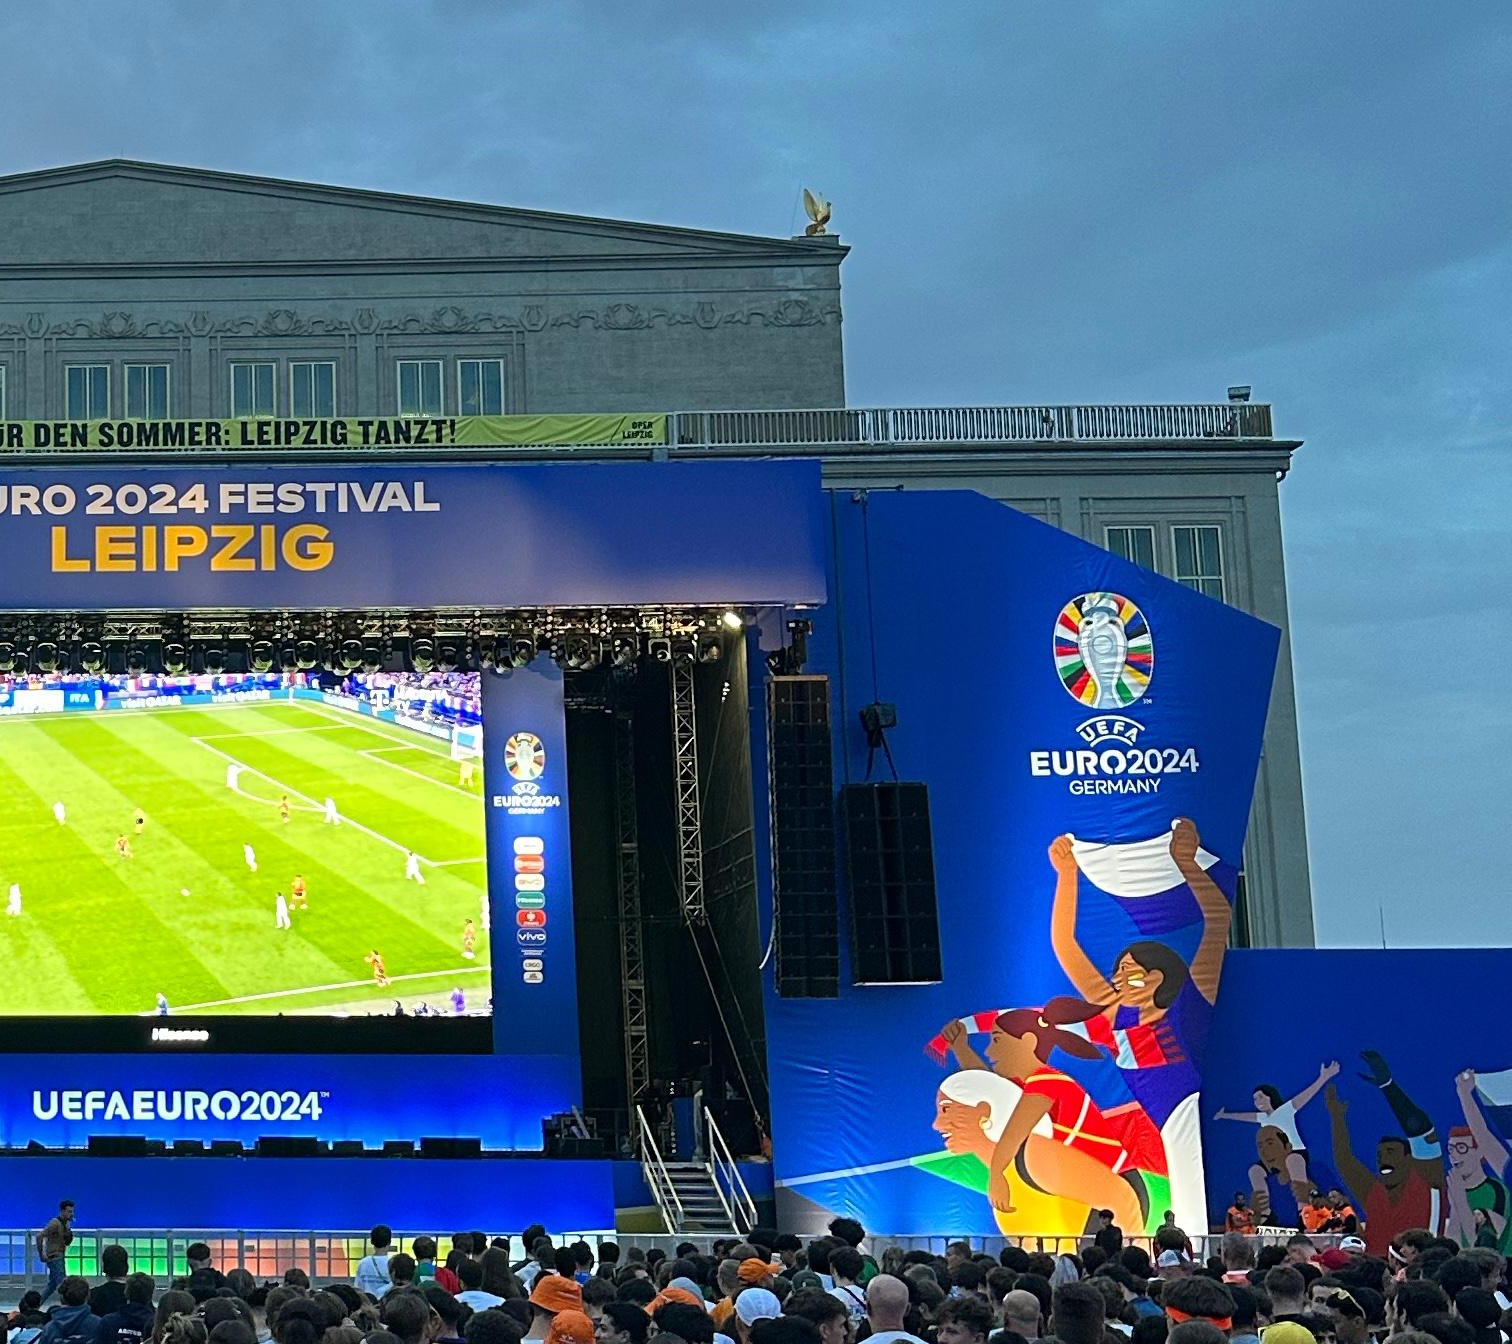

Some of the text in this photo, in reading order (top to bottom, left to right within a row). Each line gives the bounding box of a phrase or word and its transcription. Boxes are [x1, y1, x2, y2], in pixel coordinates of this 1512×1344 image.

[34, 422, 88, 449] DEN
[98, 421, 231, 447] SOMMER:
[240, 420, 348, 446] LEIPZIG
[357, 419, 457, 445] TANZT!
[85, 482, 210, 515] 2024
[219, 481, 441, 514] FESTIVAL
[51, 523, 335, 573] LEIPZIG
[1080, 720, 1138, 743] UEFA
[1030, 748, 1200, 776] EURO2024
[1069, 778, 1161, 795] GERMANY
[518, 932, 546, 941] vivo
[33, 1090, 322, 1122] UEFAEURO2024
